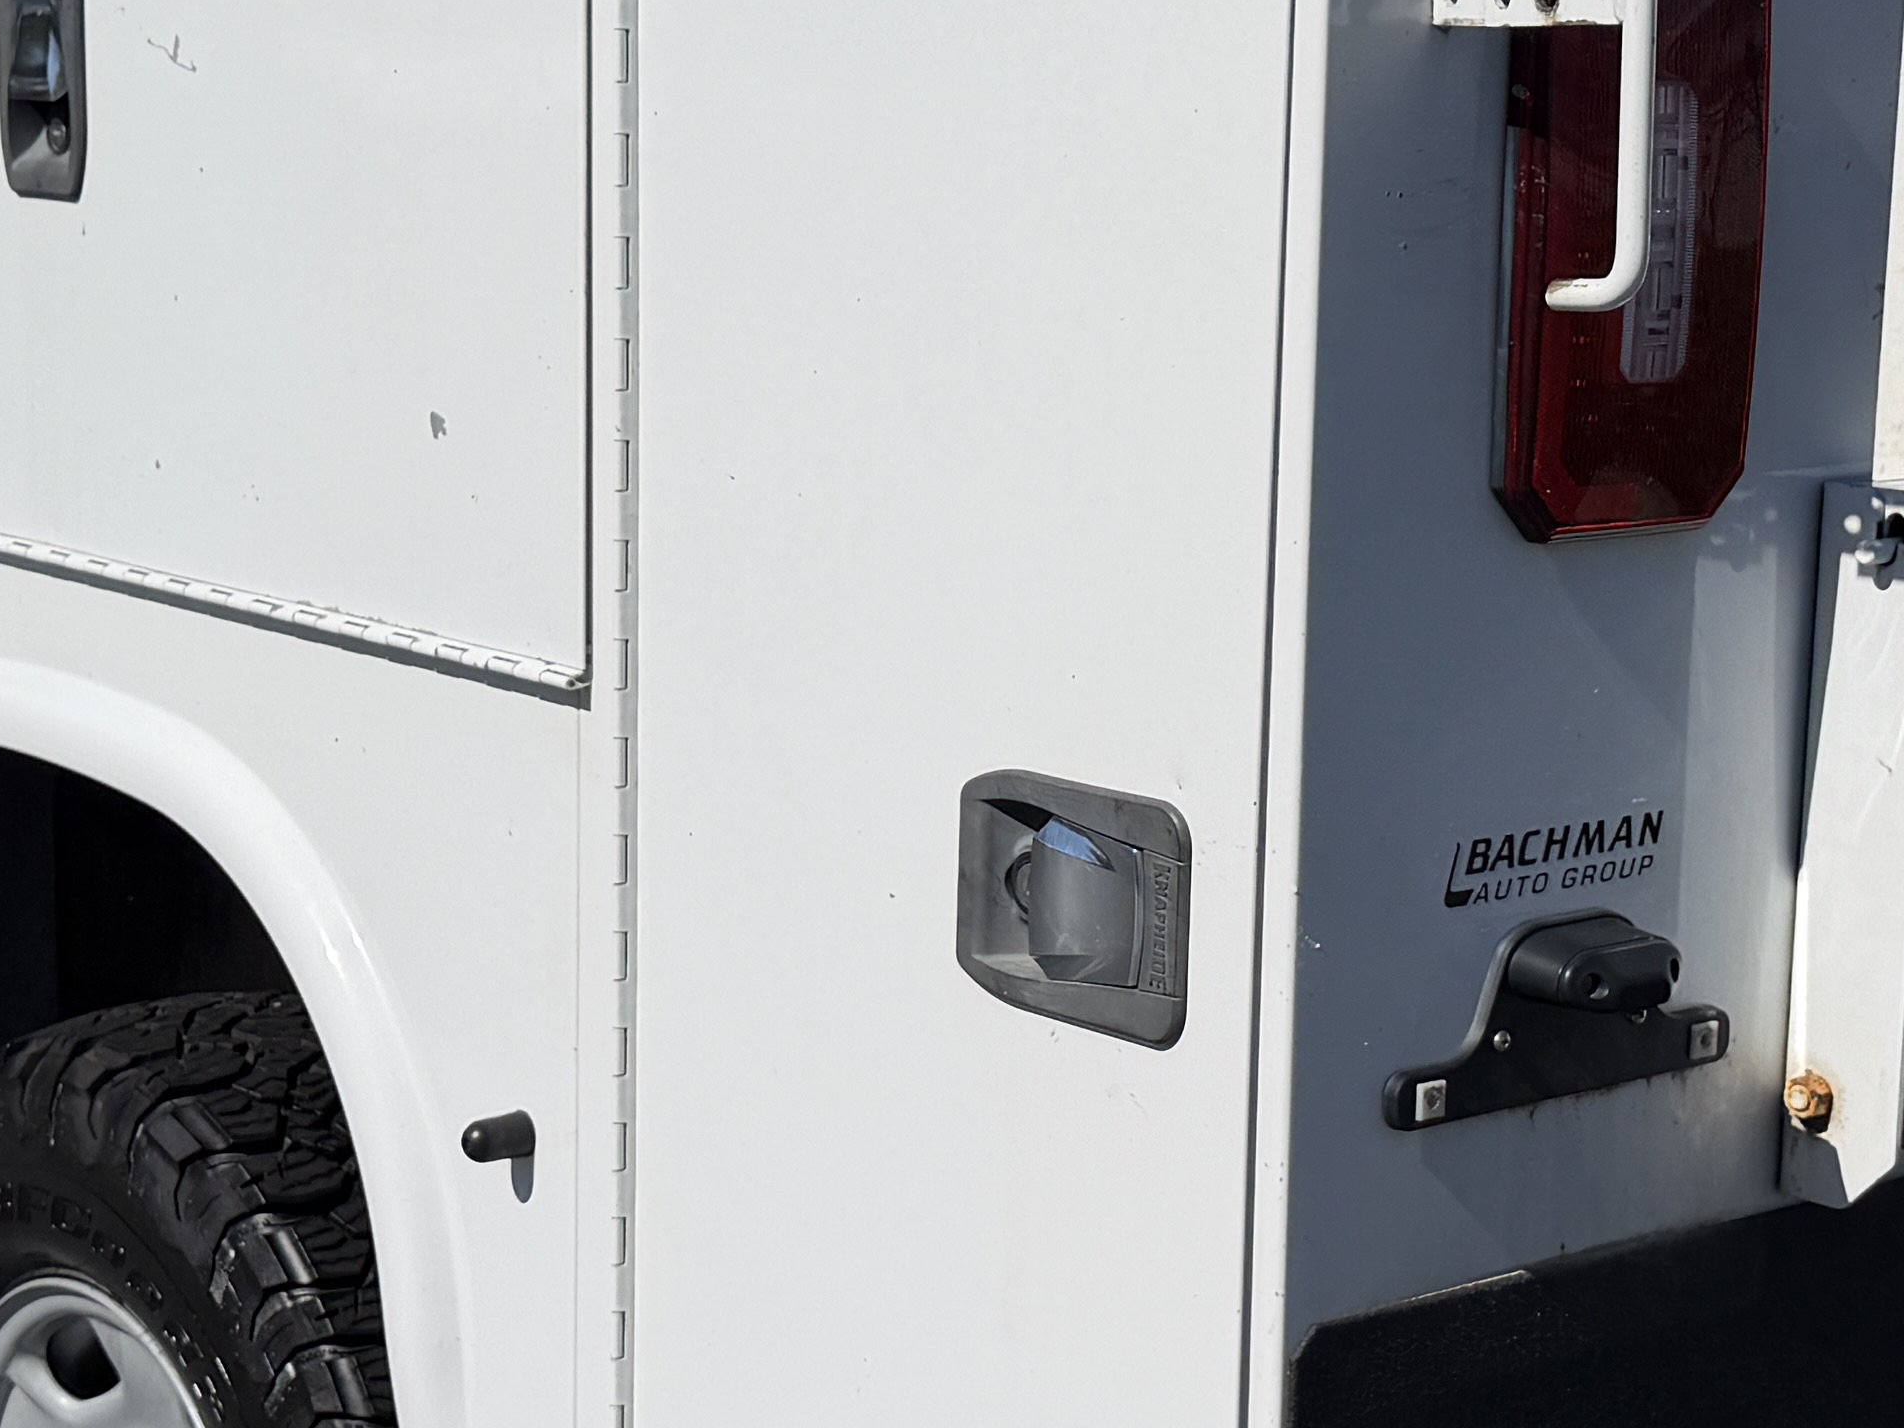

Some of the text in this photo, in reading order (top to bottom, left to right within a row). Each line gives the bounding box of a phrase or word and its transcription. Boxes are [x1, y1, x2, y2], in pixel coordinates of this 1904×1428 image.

[1464, 809, 1665, 876] BACHMAN
[1473, 853, 1656, 906] AUTO GROUP
[1147, 860, 1173, 993] KNAPHEIDE
